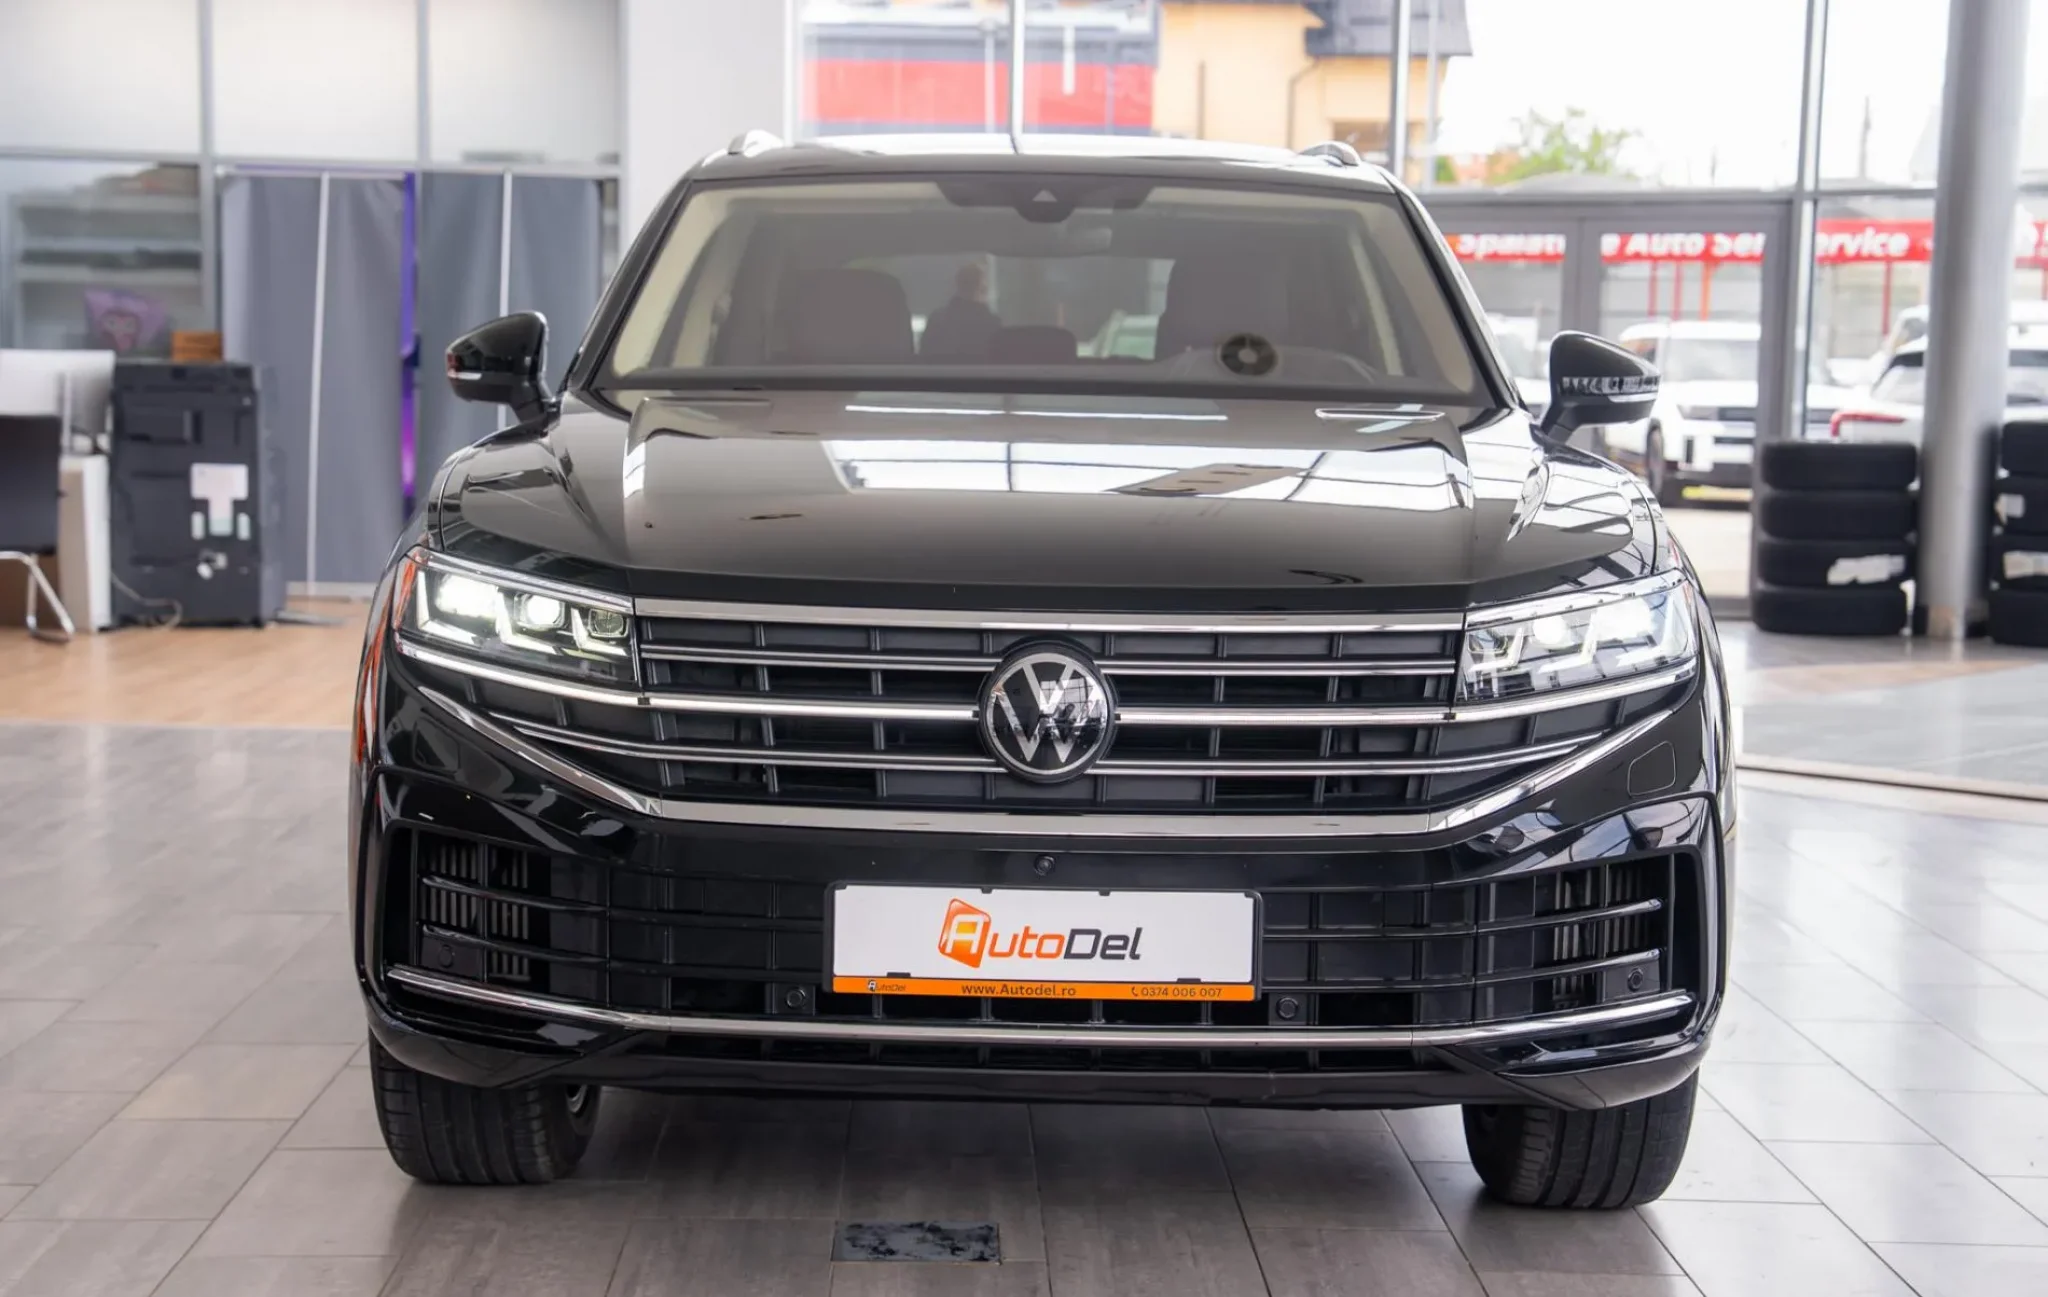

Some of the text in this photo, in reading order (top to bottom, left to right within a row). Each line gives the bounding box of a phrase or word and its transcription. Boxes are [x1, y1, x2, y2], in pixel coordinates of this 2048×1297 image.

[1625, 233, 1705, 257] Auto
[941, 905, 1143, 964] AutoDel
[961, 983, 1077, 997] www.Autodel.ro
[1141, 987, 1222, 998] 0374 006 007
